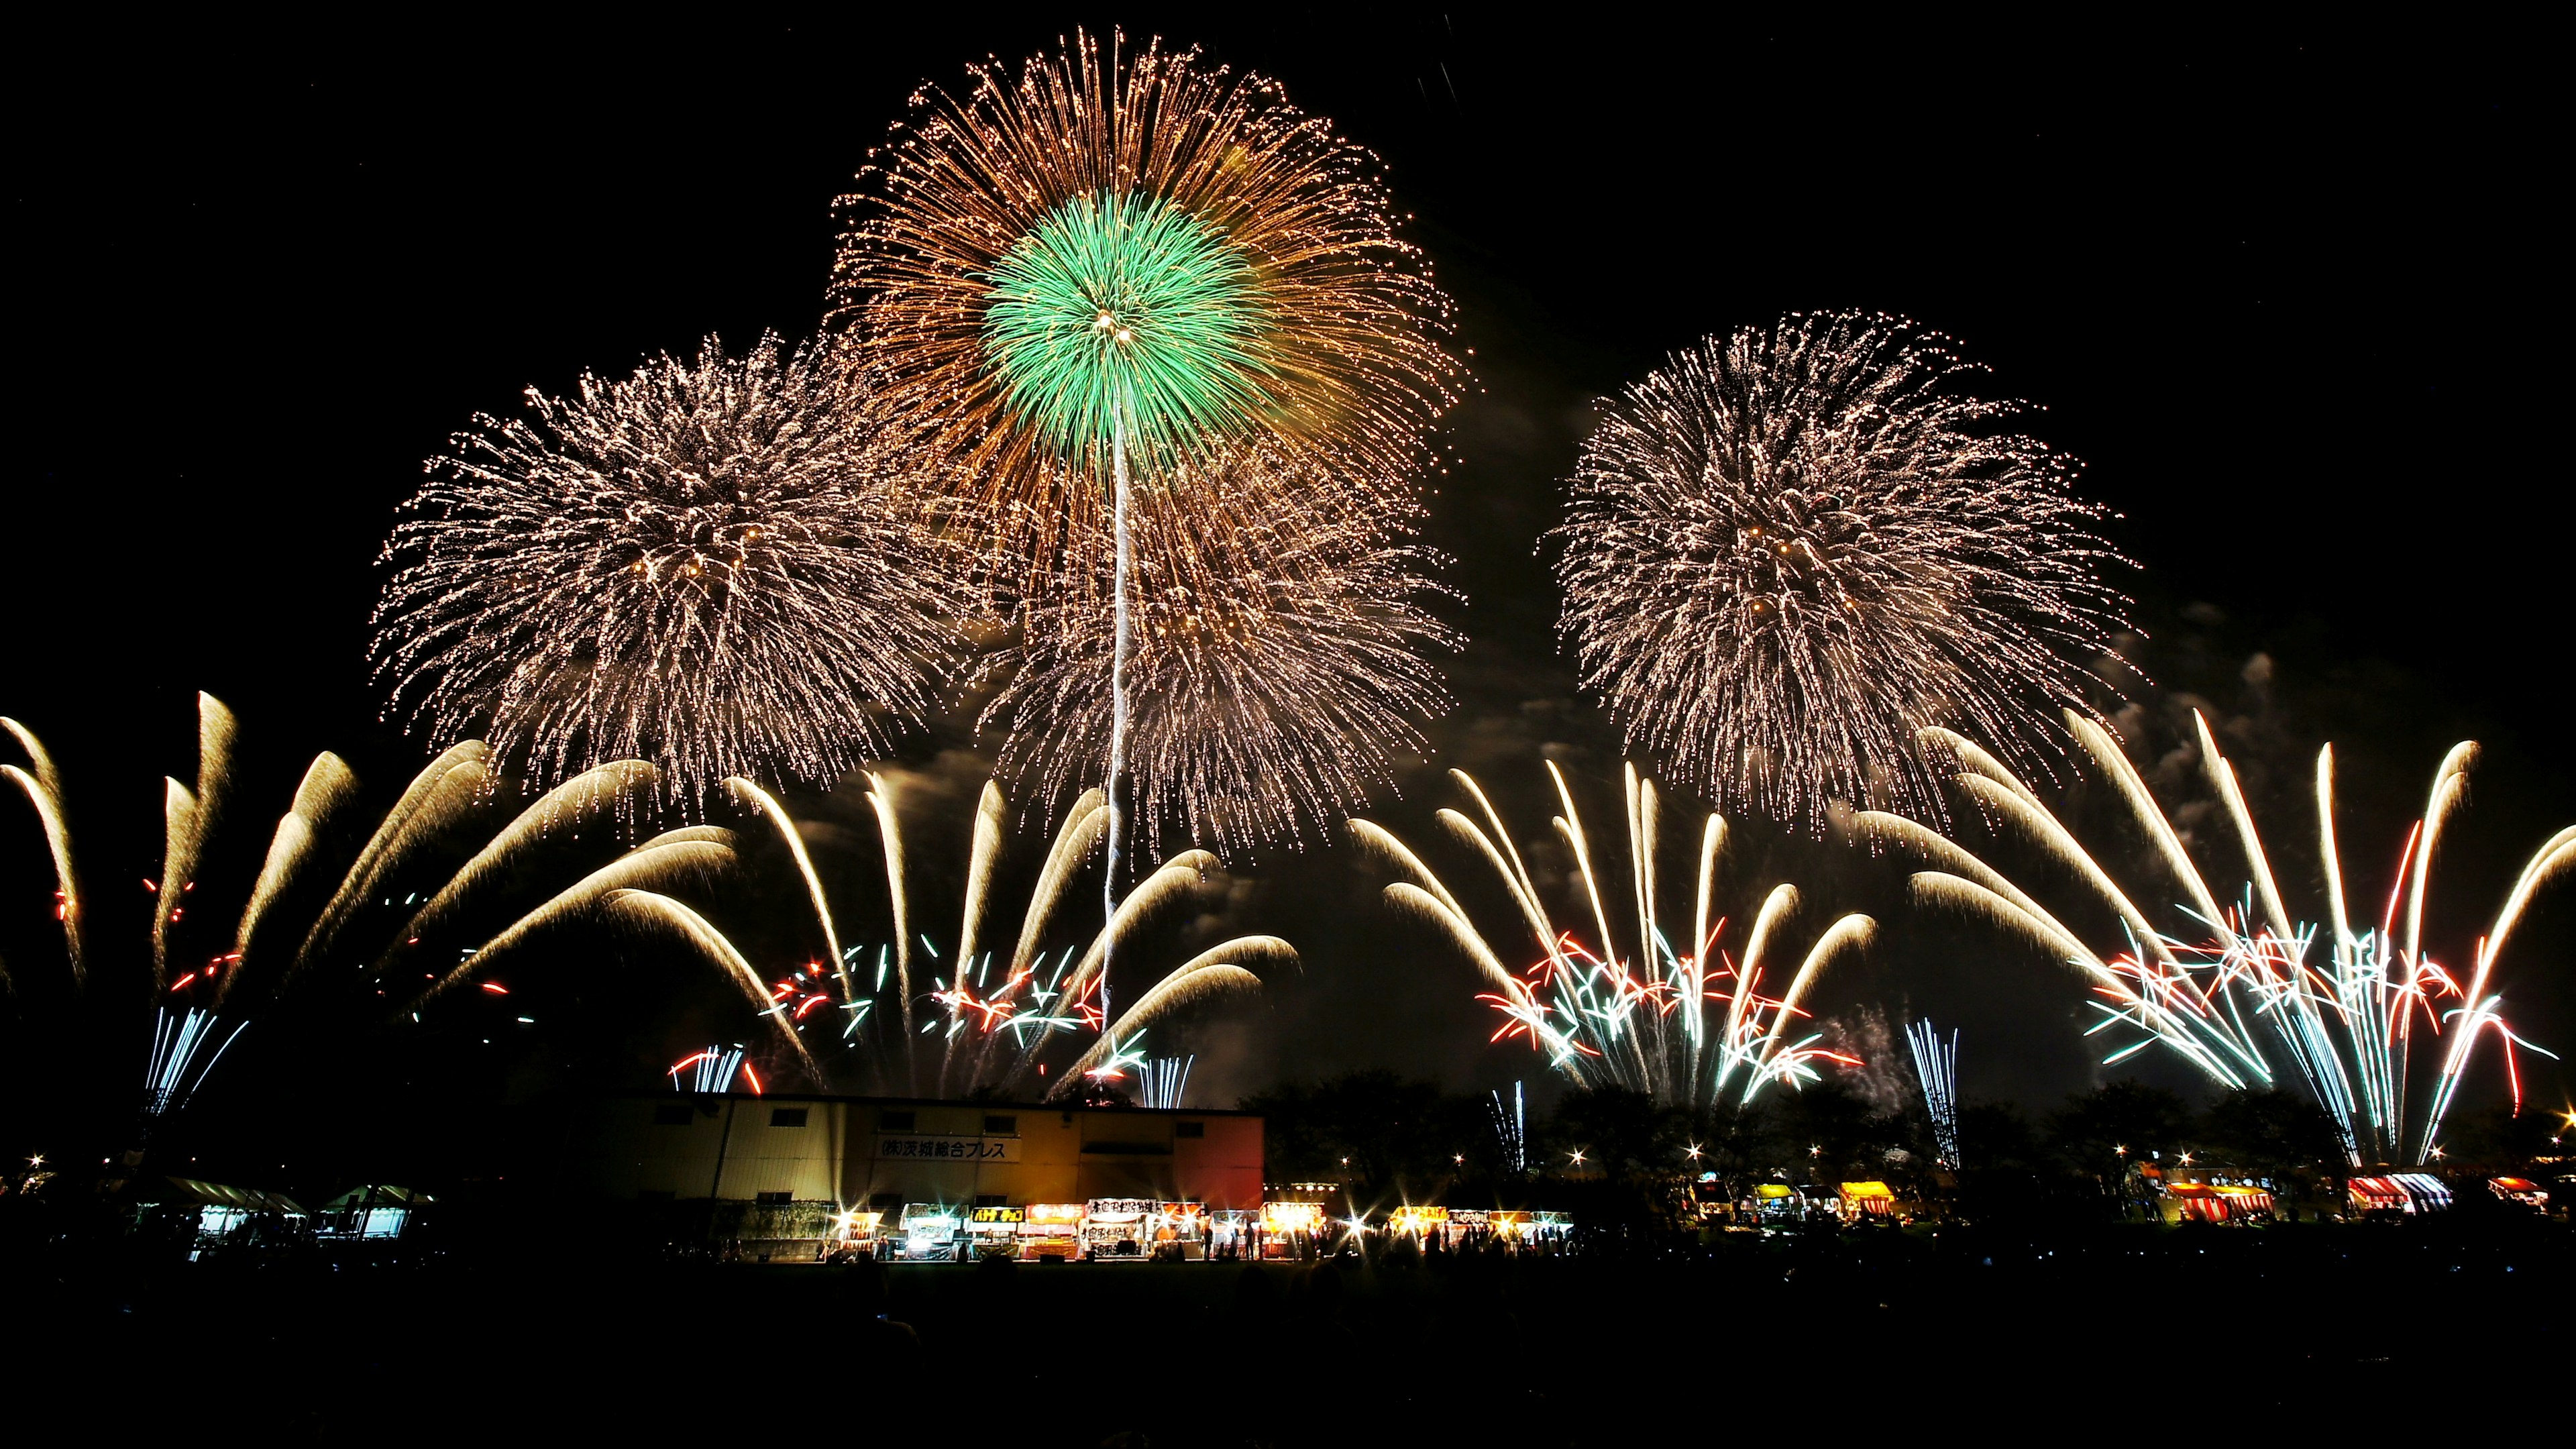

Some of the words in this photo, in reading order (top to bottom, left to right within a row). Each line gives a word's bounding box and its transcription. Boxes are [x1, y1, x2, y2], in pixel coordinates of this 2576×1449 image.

[882, 1140, 1005, 1159] (株)茨城総合プレス
